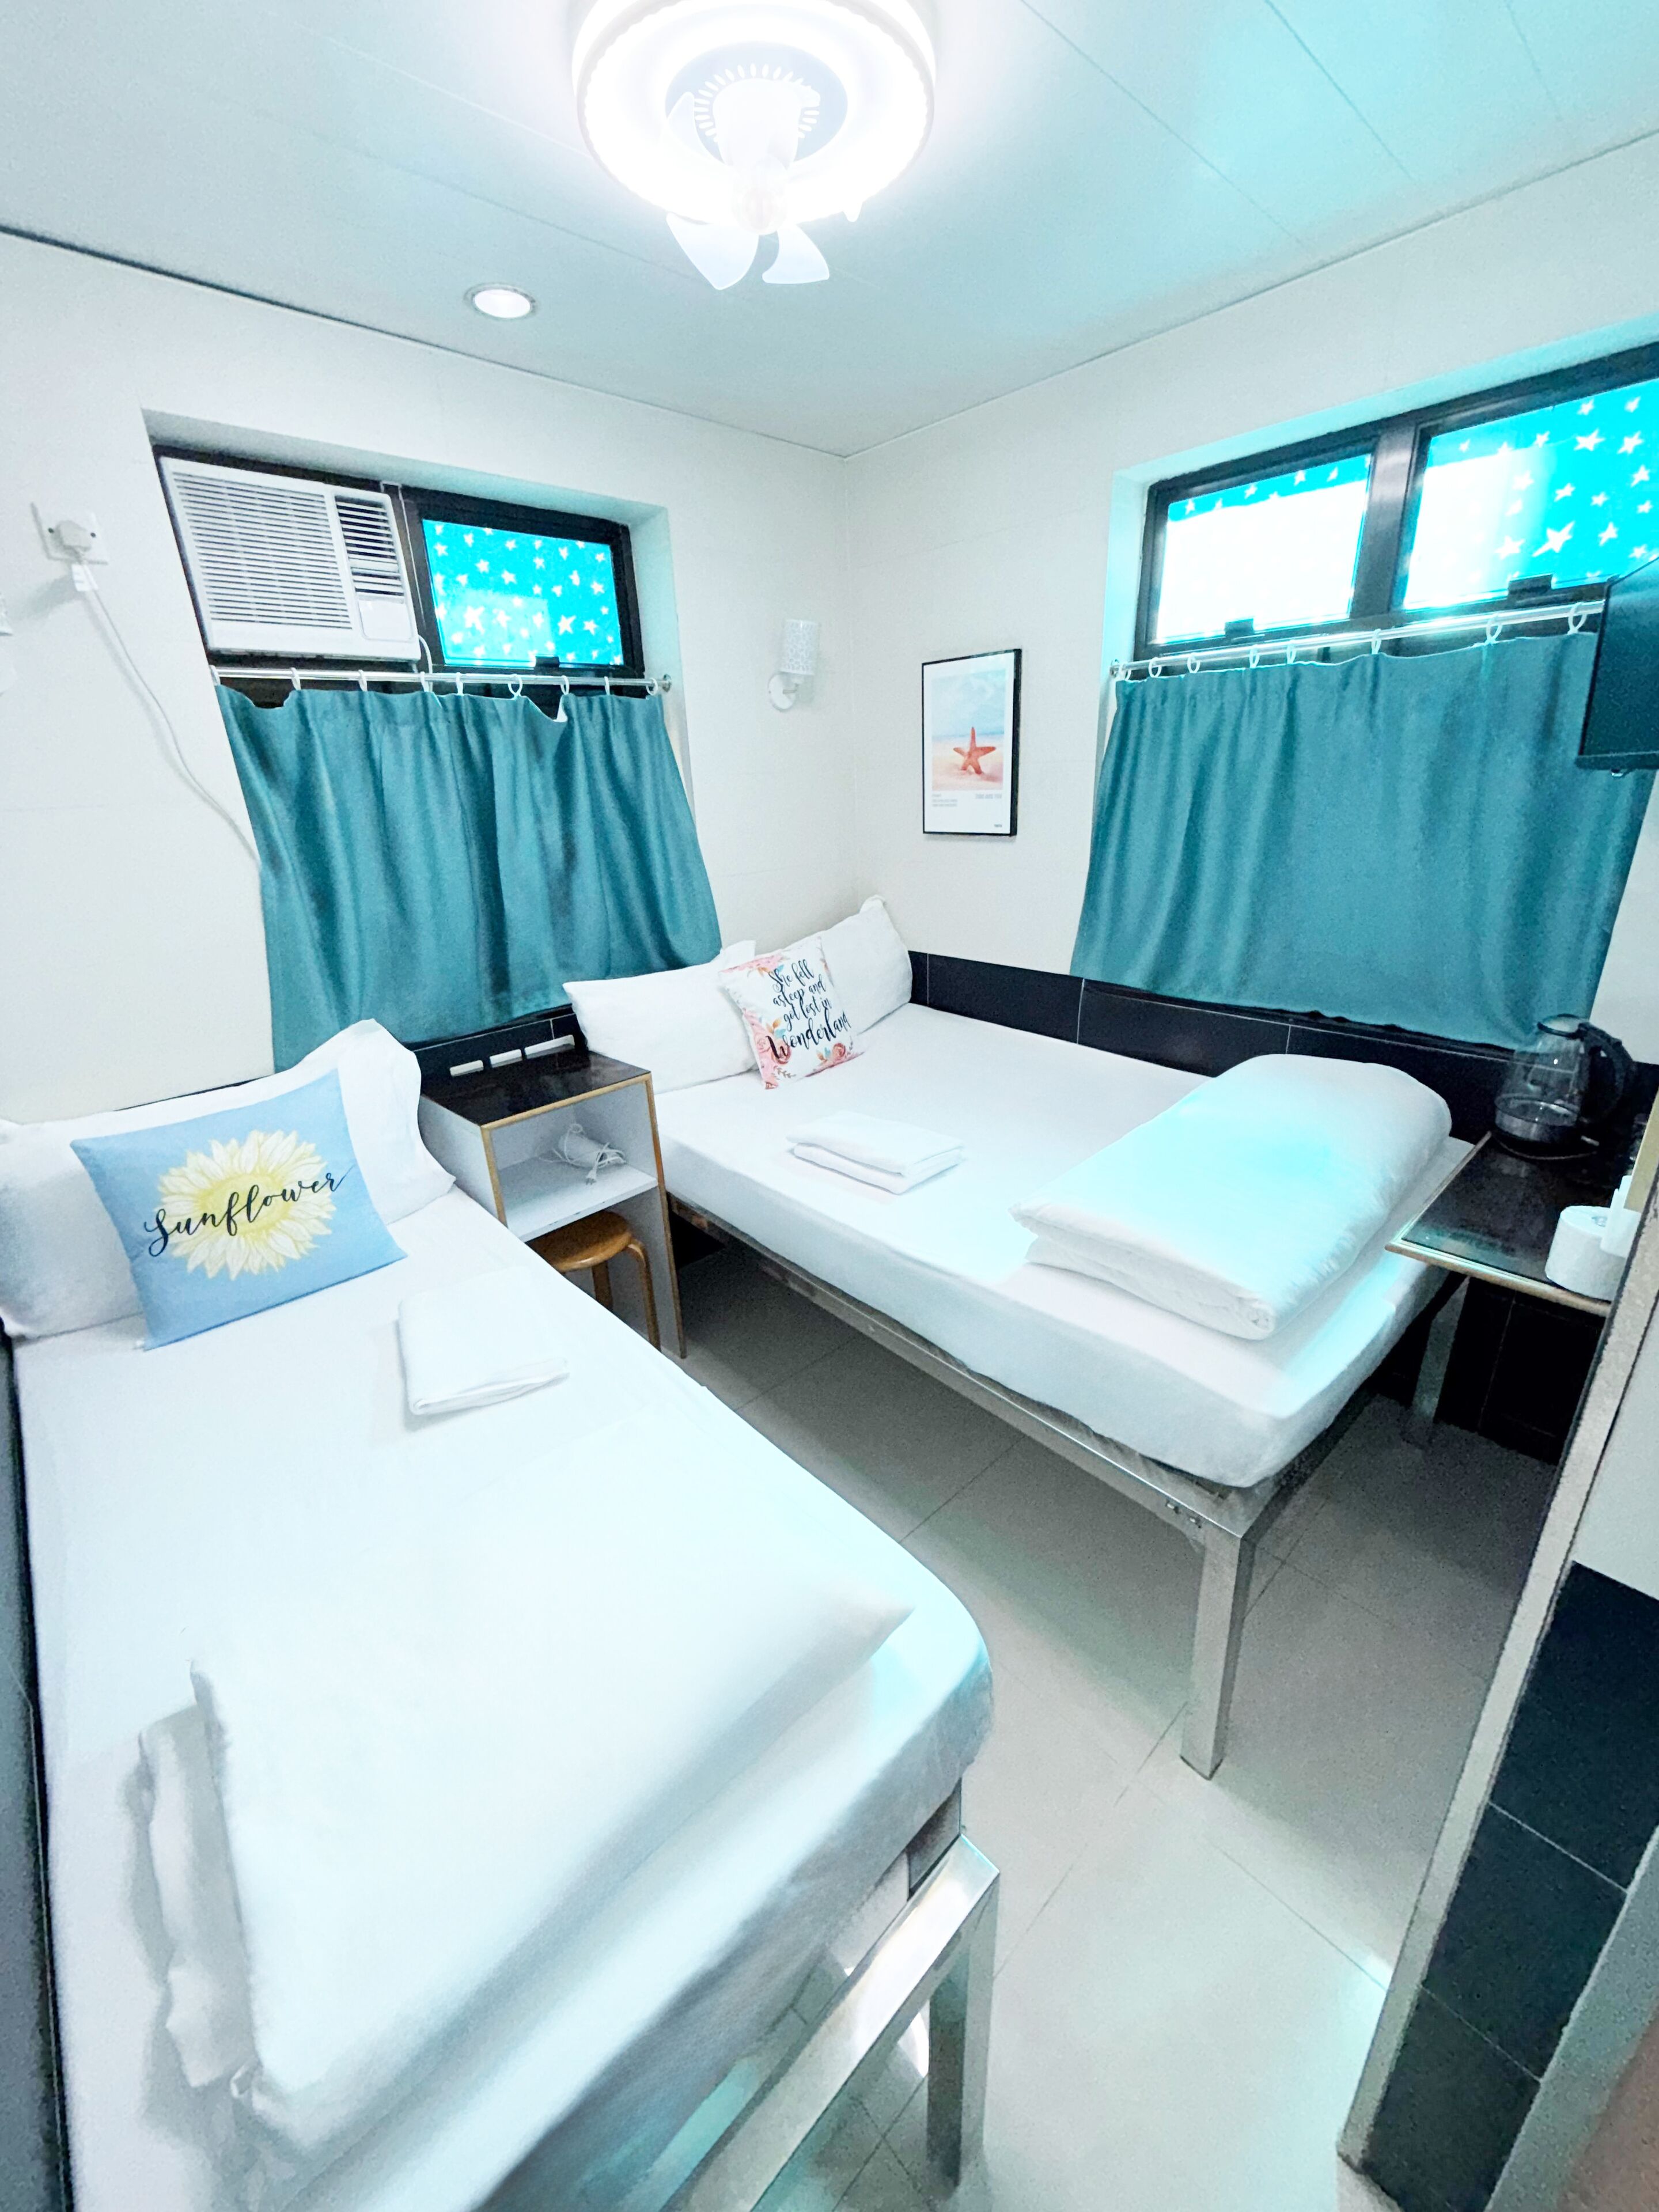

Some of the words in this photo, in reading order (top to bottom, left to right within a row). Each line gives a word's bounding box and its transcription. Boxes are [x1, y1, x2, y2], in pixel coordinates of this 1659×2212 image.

[768, 968, 793, 993] She
[791, 959, 815, 986] fell
[772, 984, 805, 1007] asleep
[808, 975, 826, 994] and
[783, 1003, 800, 1032] got
[800, 996, 820, 1018] lost
[820, 997, 832, 1010] in
[766, 1008, 851, 1059] Wonderland
[144, 1164, 355, 1256] Sunflower
